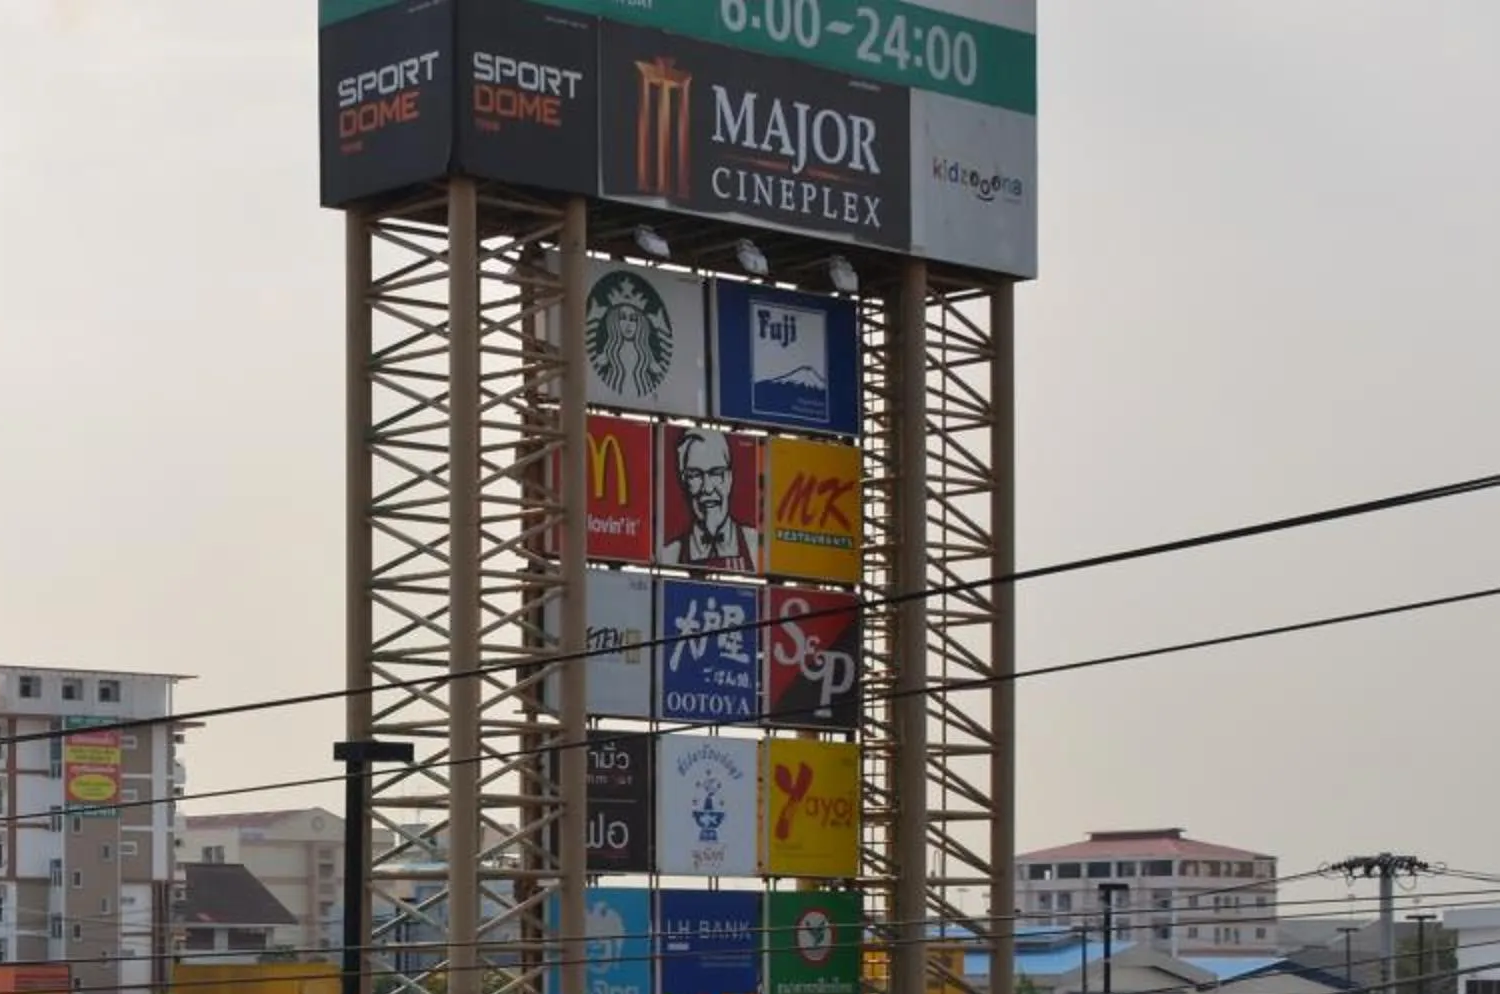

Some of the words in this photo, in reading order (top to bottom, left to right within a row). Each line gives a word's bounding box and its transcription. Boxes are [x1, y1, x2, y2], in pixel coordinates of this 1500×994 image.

[337, 51, 440, 107] SPORT
[472, 51, 583, 99] SPORT
[338, 90, 421, 138] DOME
[472, 83, 563, 127] DOME
[711, 84, 881, 174] MAJOR
[711, 167, 882, 228] CINEPLEX
[757, 308, 798, 348] Fuji
[775, 472, 853, 531] MK
[667, 690, 751, 716] OOTOYA
[667, 919, 690, 940] LH
[698, 918, 752, 940] BANK
